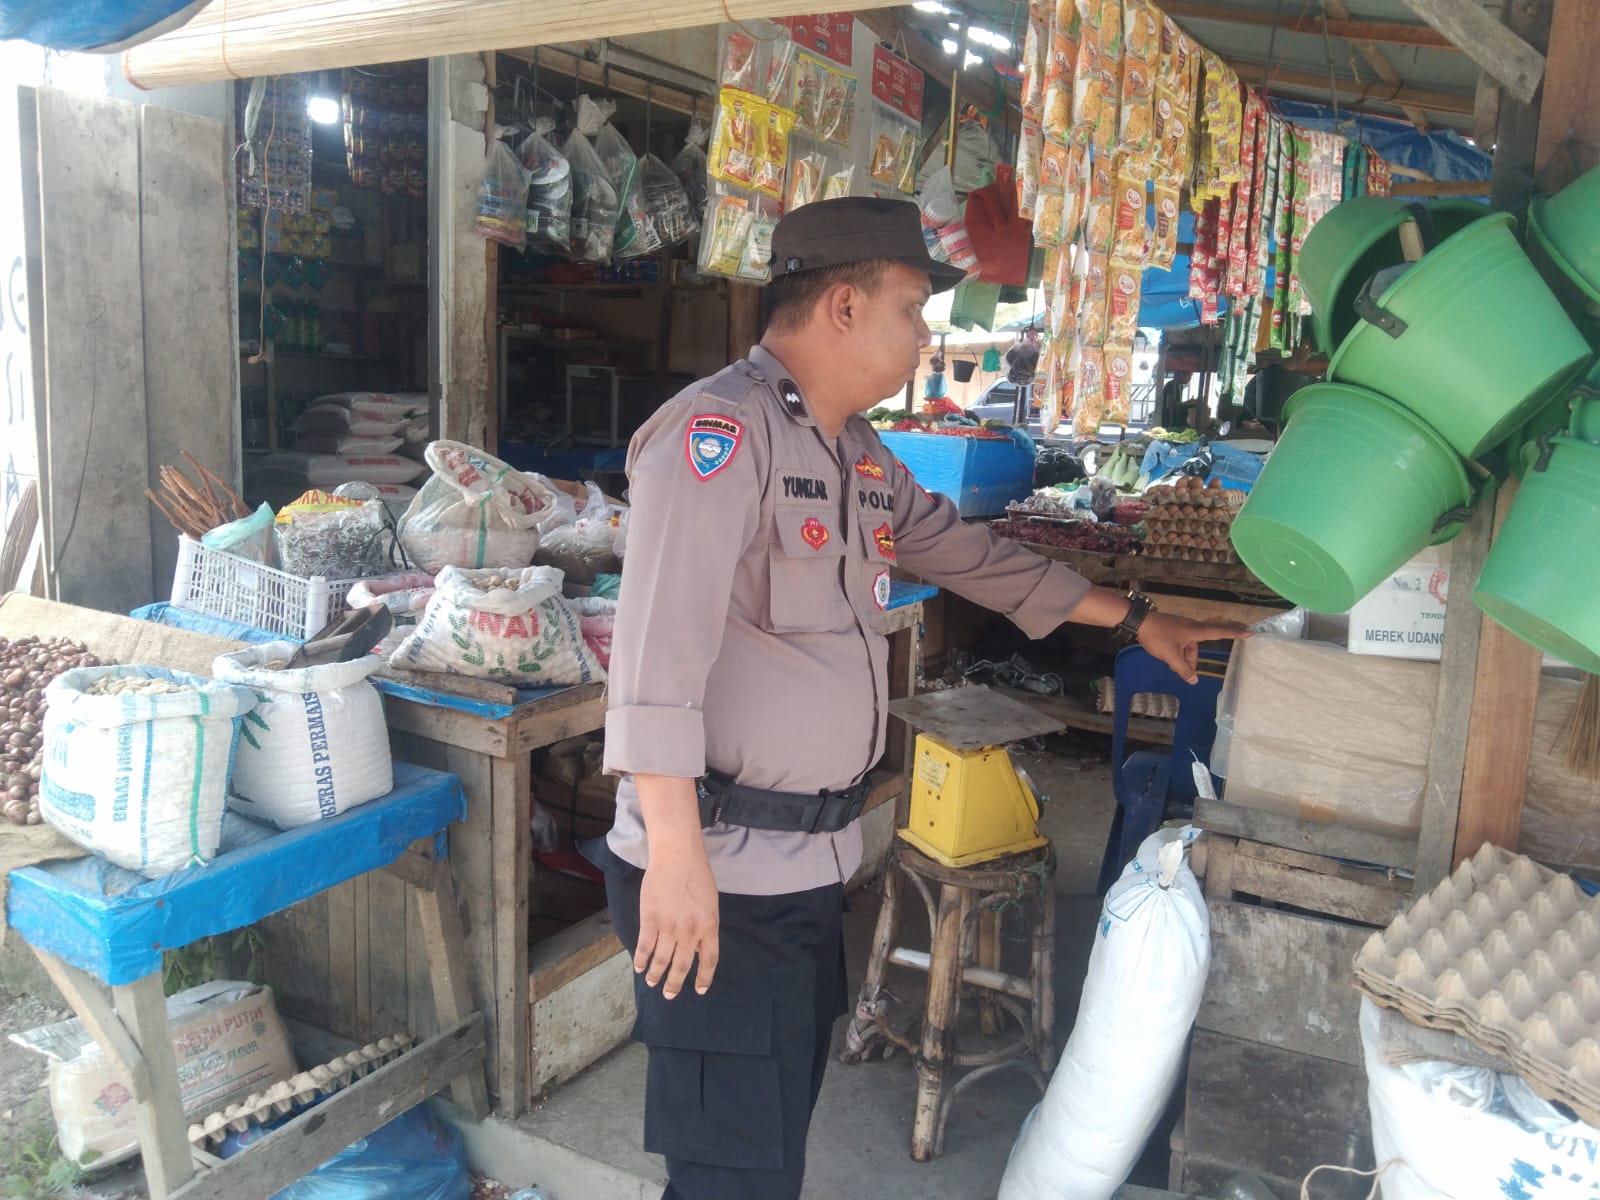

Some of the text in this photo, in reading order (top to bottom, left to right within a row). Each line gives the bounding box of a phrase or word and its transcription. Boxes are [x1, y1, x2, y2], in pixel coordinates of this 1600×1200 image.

[1392, 577, 1422, 591] No. 2
[1365, 629, 1405, 643] MEREK
[315, 767, 337, 820] BERAS
